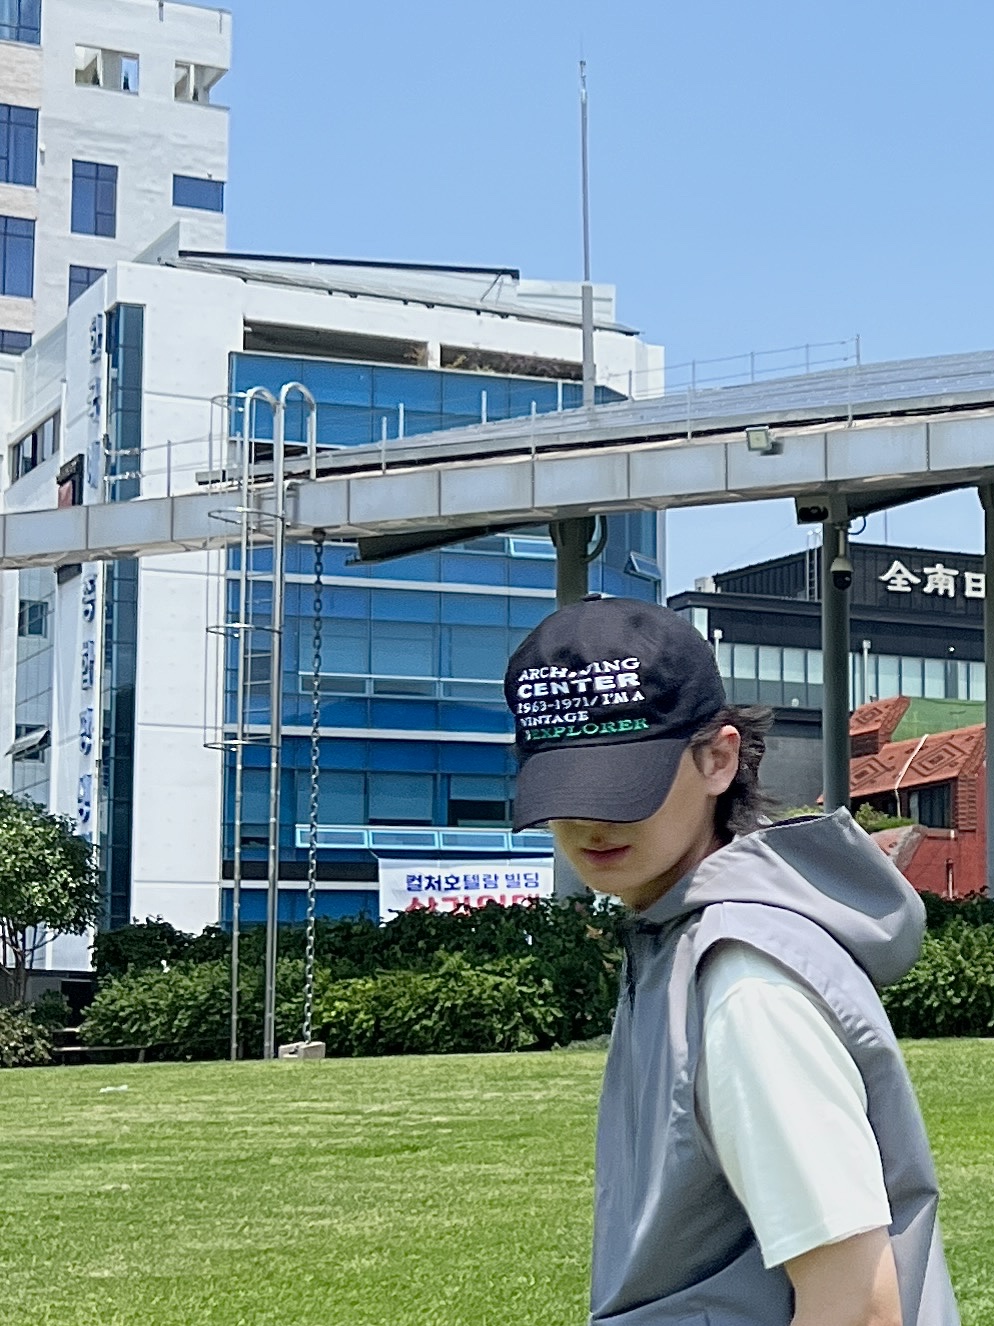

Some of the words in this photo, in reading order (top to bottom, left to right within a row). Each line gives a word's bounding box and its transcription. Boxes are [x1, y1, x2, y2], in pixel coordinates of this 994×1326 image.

[517, 672, 641, 699] CENTER
[602, 692, 629, 706] I'M
[632, 690, 645, 702] A
[520, 711, 589, 727] VINTAGE
[530, 718, 650, 741] EXPLORER
[505, 872, 540, 889] 빌딩
